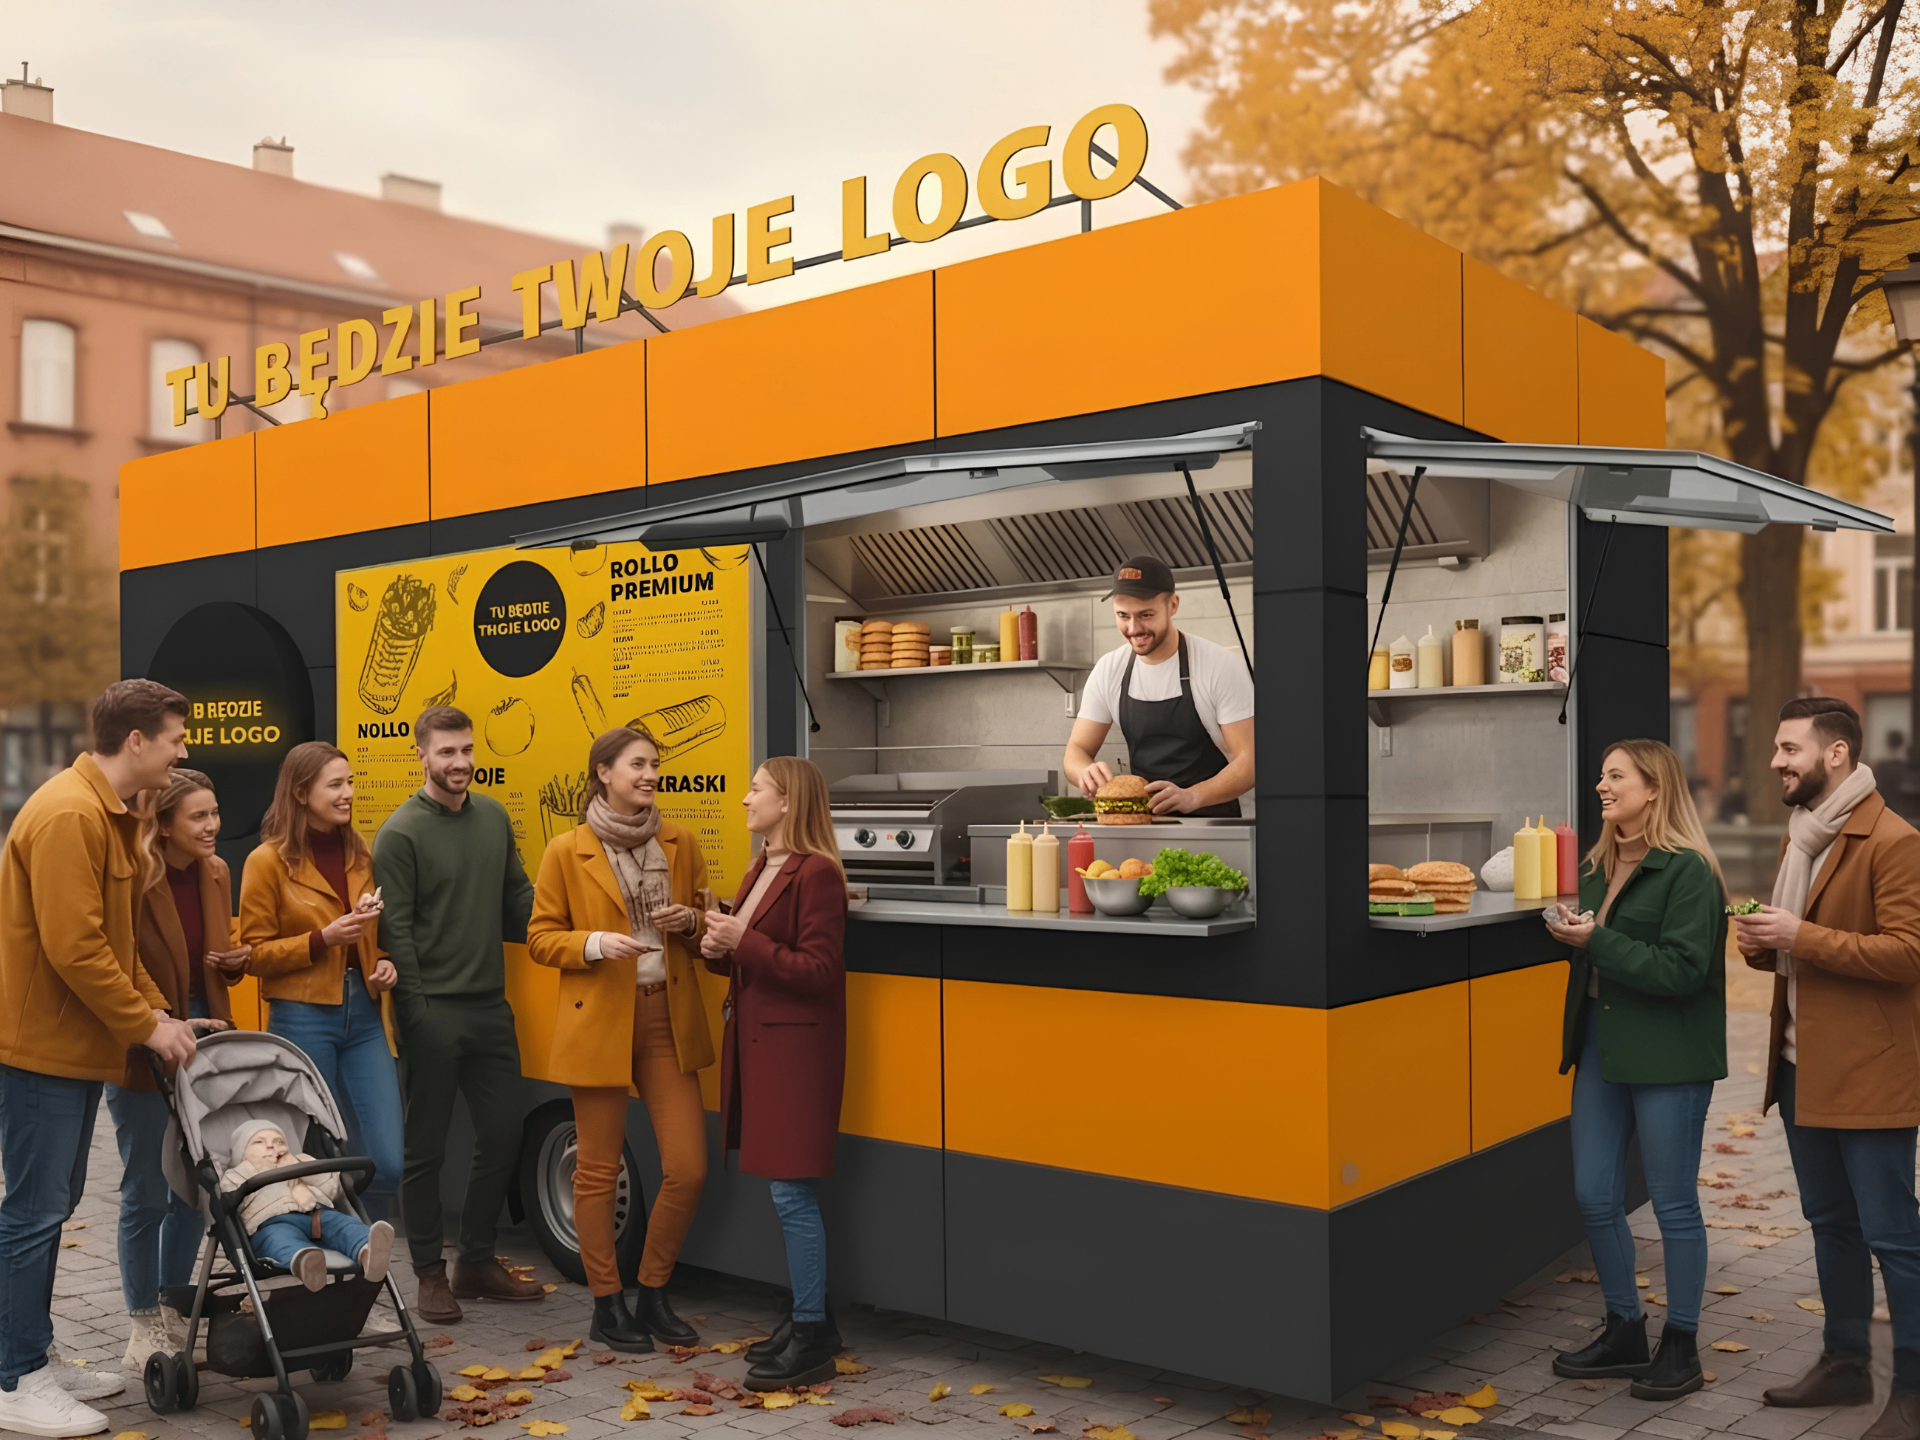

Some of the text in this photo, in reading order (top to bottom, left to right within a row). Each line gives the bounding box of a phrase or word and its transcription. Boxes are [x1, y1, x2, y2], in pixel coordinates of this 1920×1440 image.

[165, 103, 1149, 427] TU BĘDZIE TWOJE LOGO
[610, 553, 679, 579] ROLLO
[611, 572, 714, 602] PREMIUM
[220, 725, 281, 745] LOGO
[358, 721, 410, 739] NOLLO
